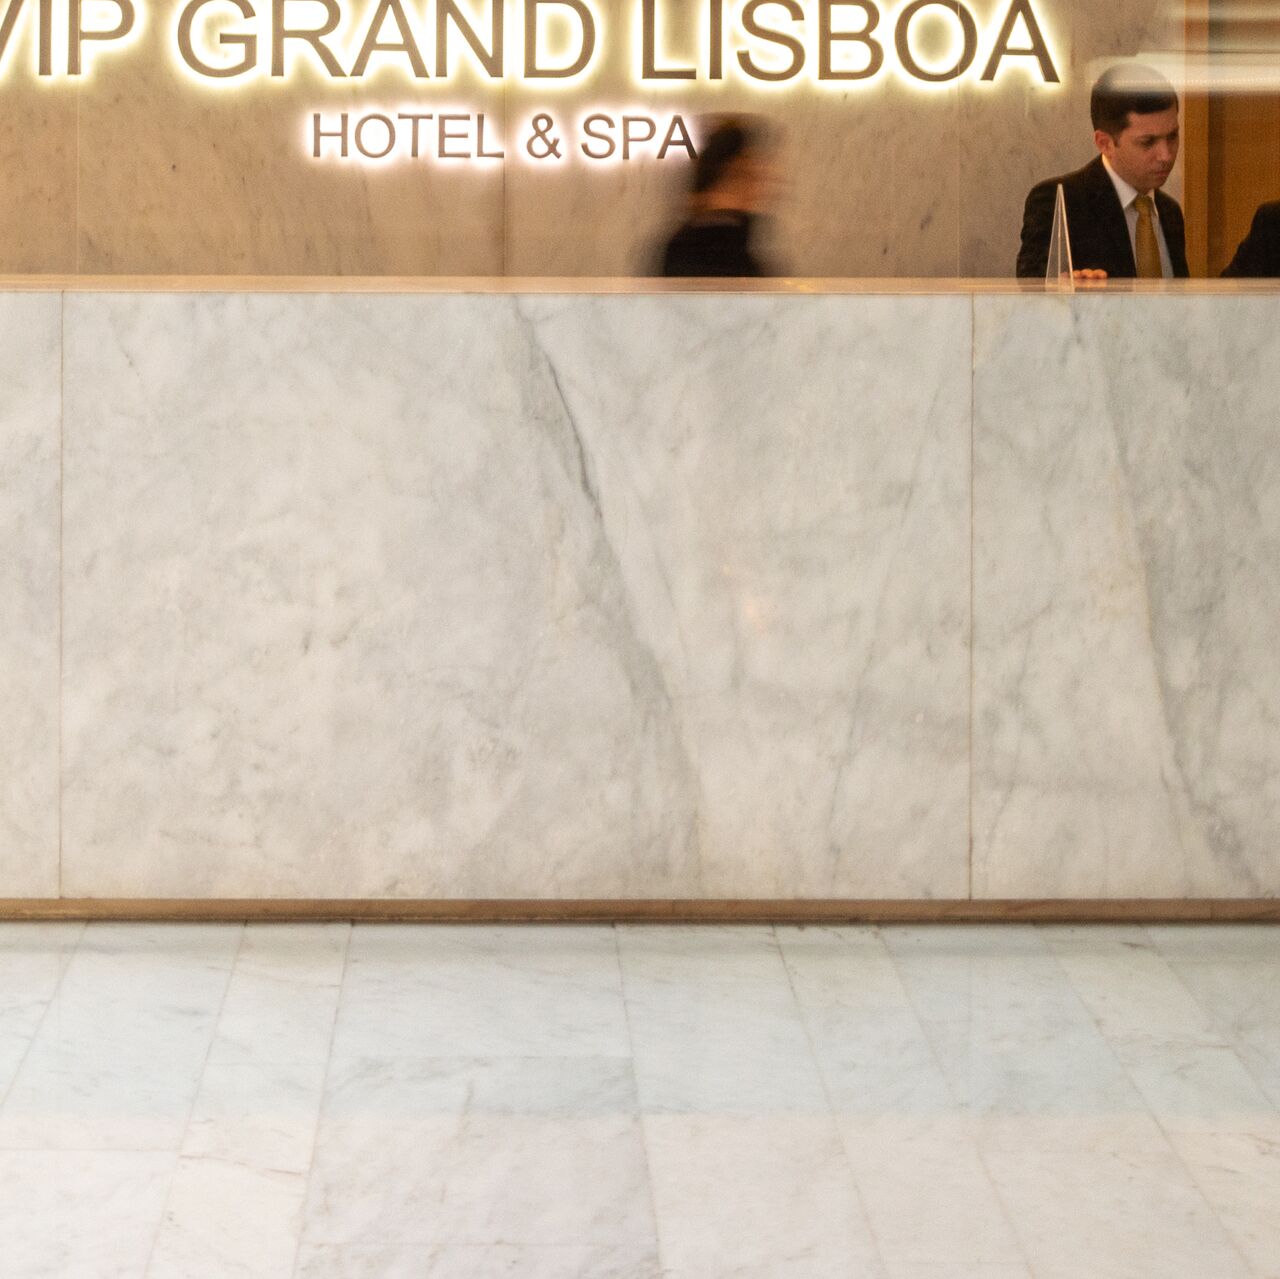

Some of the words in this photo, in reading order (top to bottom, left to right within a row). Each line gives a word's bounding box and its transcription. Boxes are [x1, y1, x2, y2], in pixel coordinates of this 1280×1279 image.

[313, 112, 504, 158] HOTEL
[526, 113, 562, 159] &
[581, 113, 698, 161] SPA
